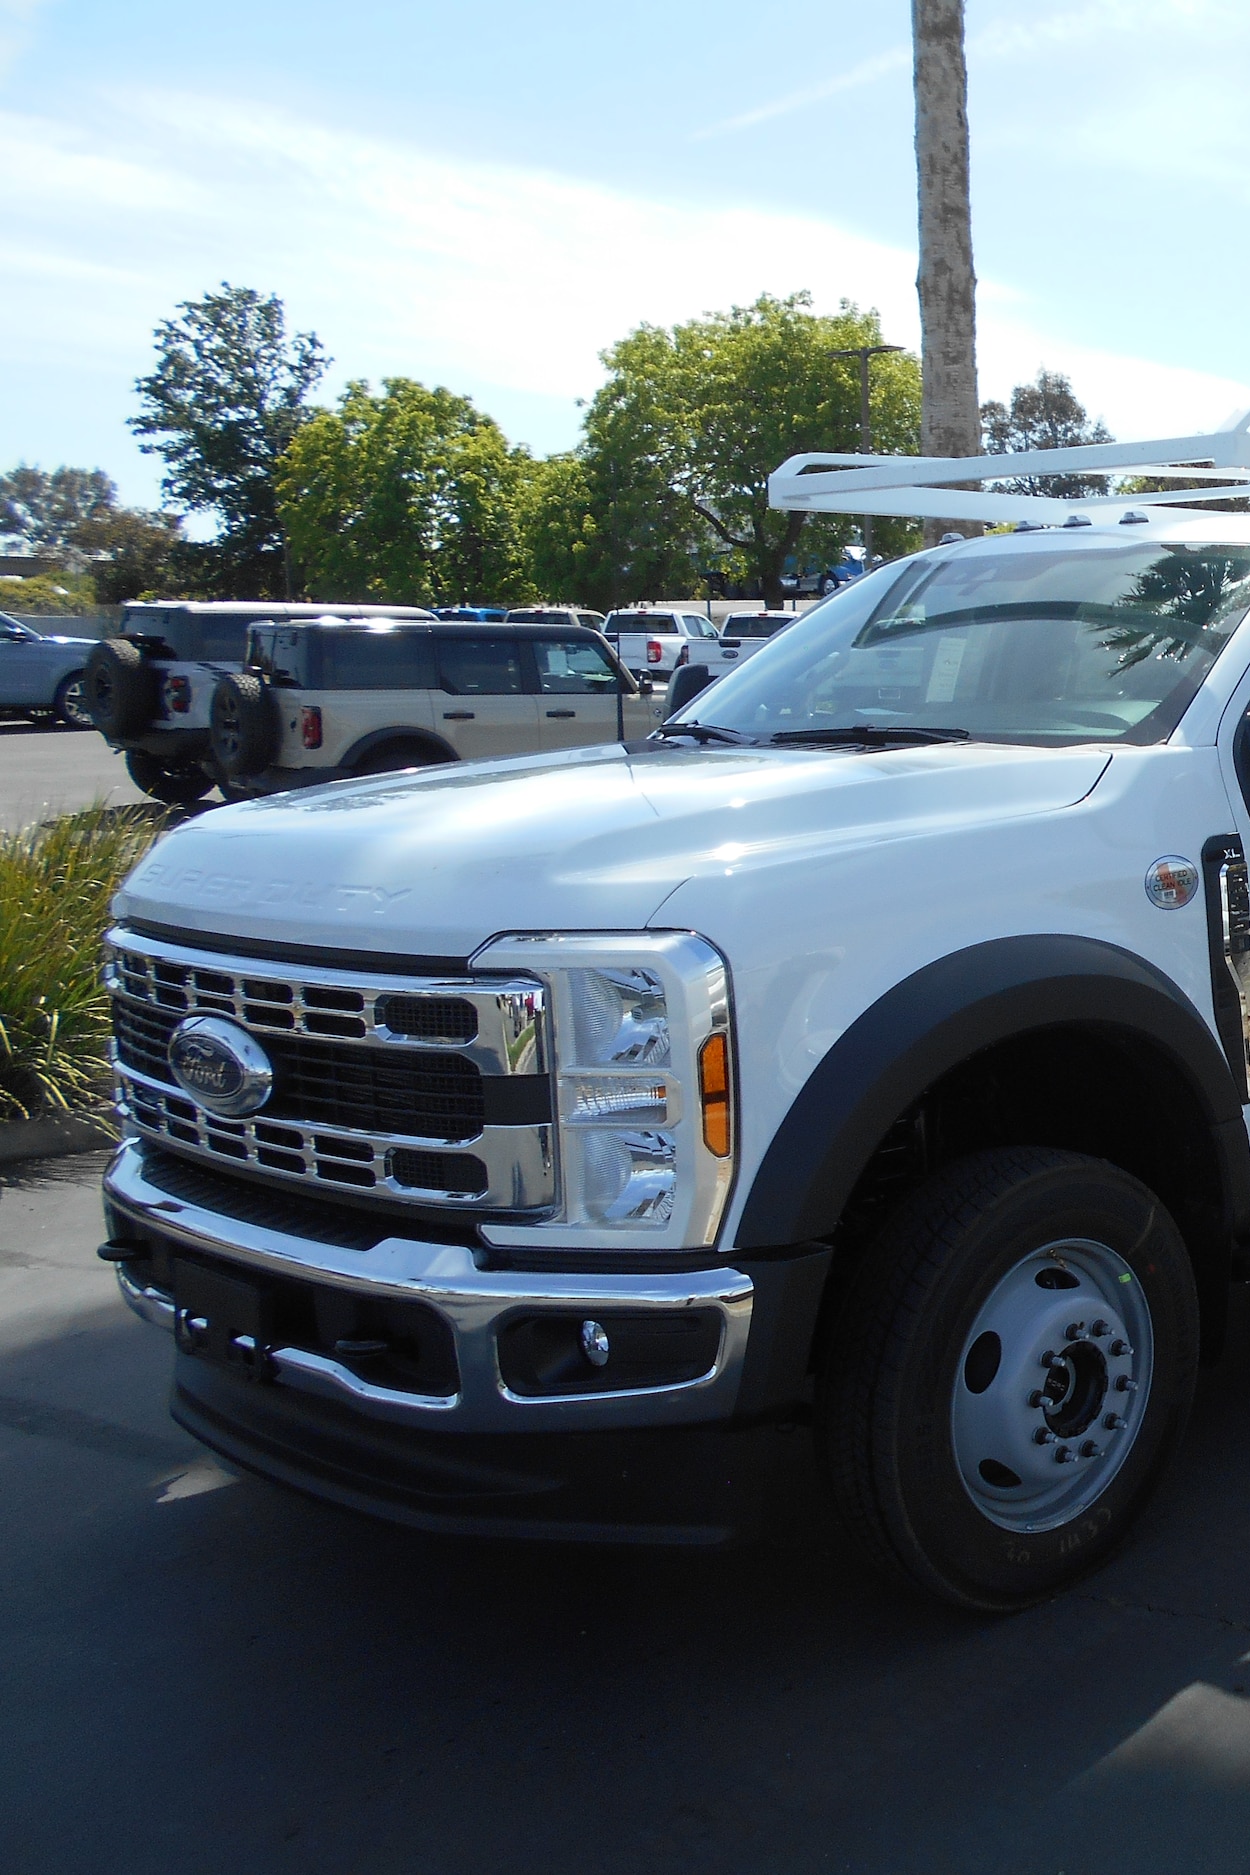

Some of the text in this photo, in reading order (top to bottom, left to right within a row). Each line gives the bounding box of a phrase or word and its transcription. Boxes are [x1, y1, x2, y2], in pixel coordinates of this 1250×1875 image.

[1223, 848, 1240, 859] XL
[1155, 870, 1187, 882] CERTIFIED
[1154, 881, 1176, 891] CLEAN
[181, 1043, 228, 1089] Ford
